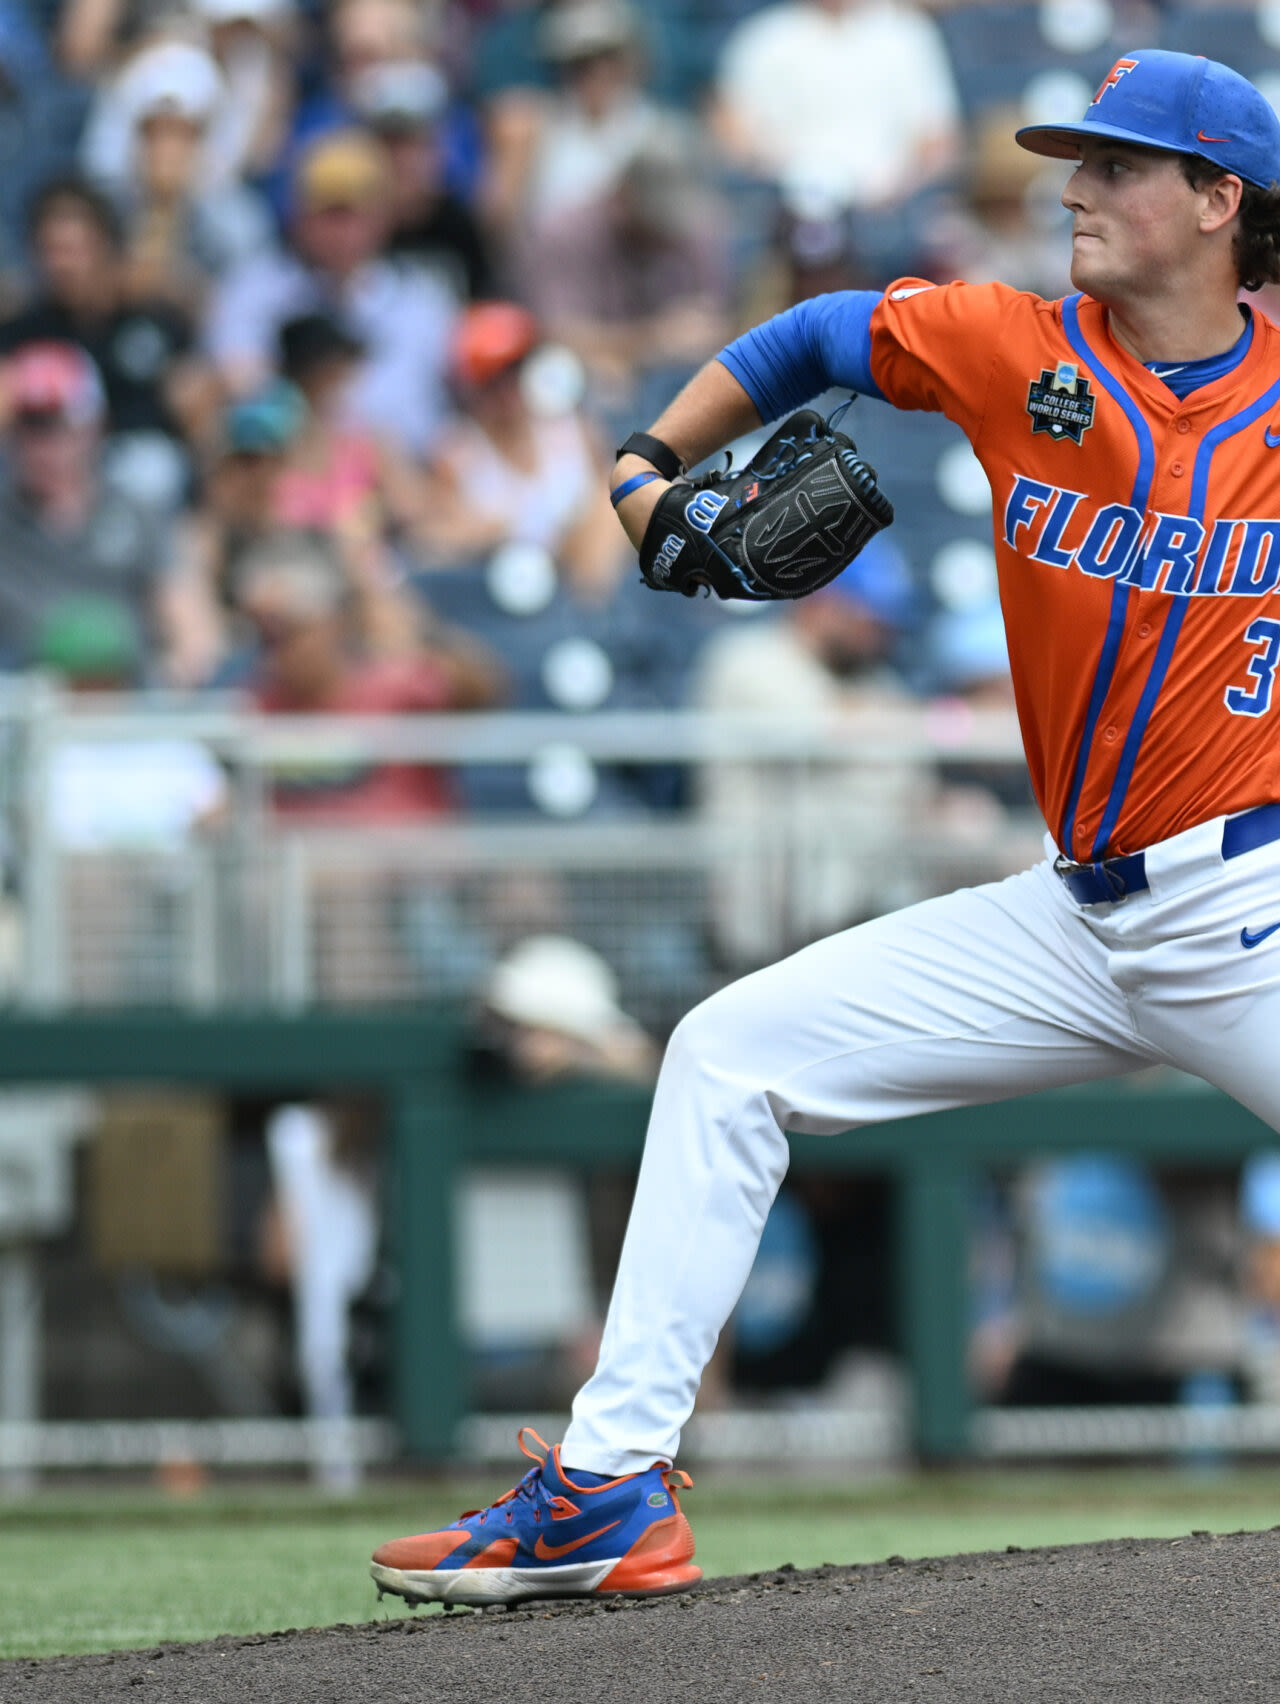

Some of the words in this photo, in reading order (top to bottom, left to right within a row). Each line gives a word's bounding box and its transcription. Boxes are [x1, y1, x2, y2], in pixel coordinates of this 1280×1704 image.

[1089, 58, 1139, 106] F
[1029, 402, 1060, 417] WORLD
[1060, 409, 1090, 425] SERIES
[1043, 394, 1081, 411] COLLEGE
